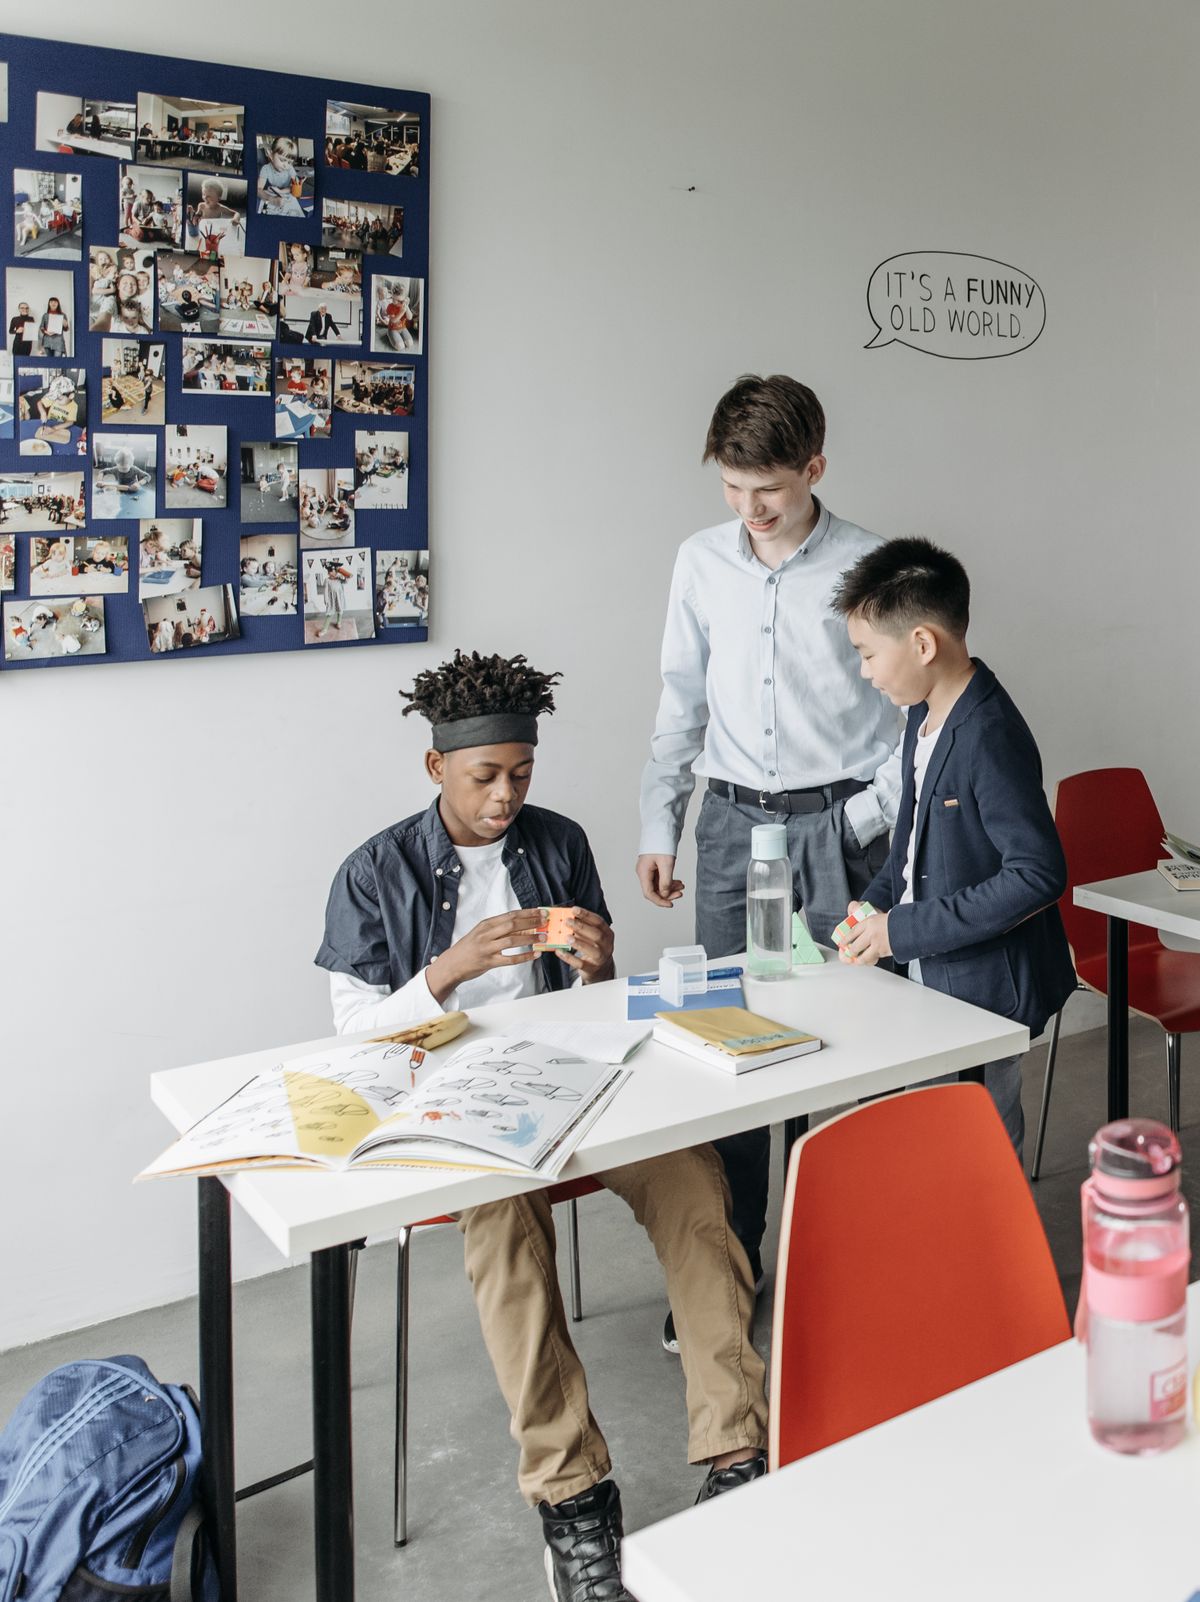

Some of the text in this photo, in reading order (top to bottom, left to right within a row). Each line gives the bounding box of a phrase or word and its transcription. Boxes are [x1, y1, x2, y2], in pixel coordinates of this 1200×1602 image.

[887, 271, 1036, 309] IT'S A FUNNY
[890, 304, 1026, 340] OLD WORLD.
